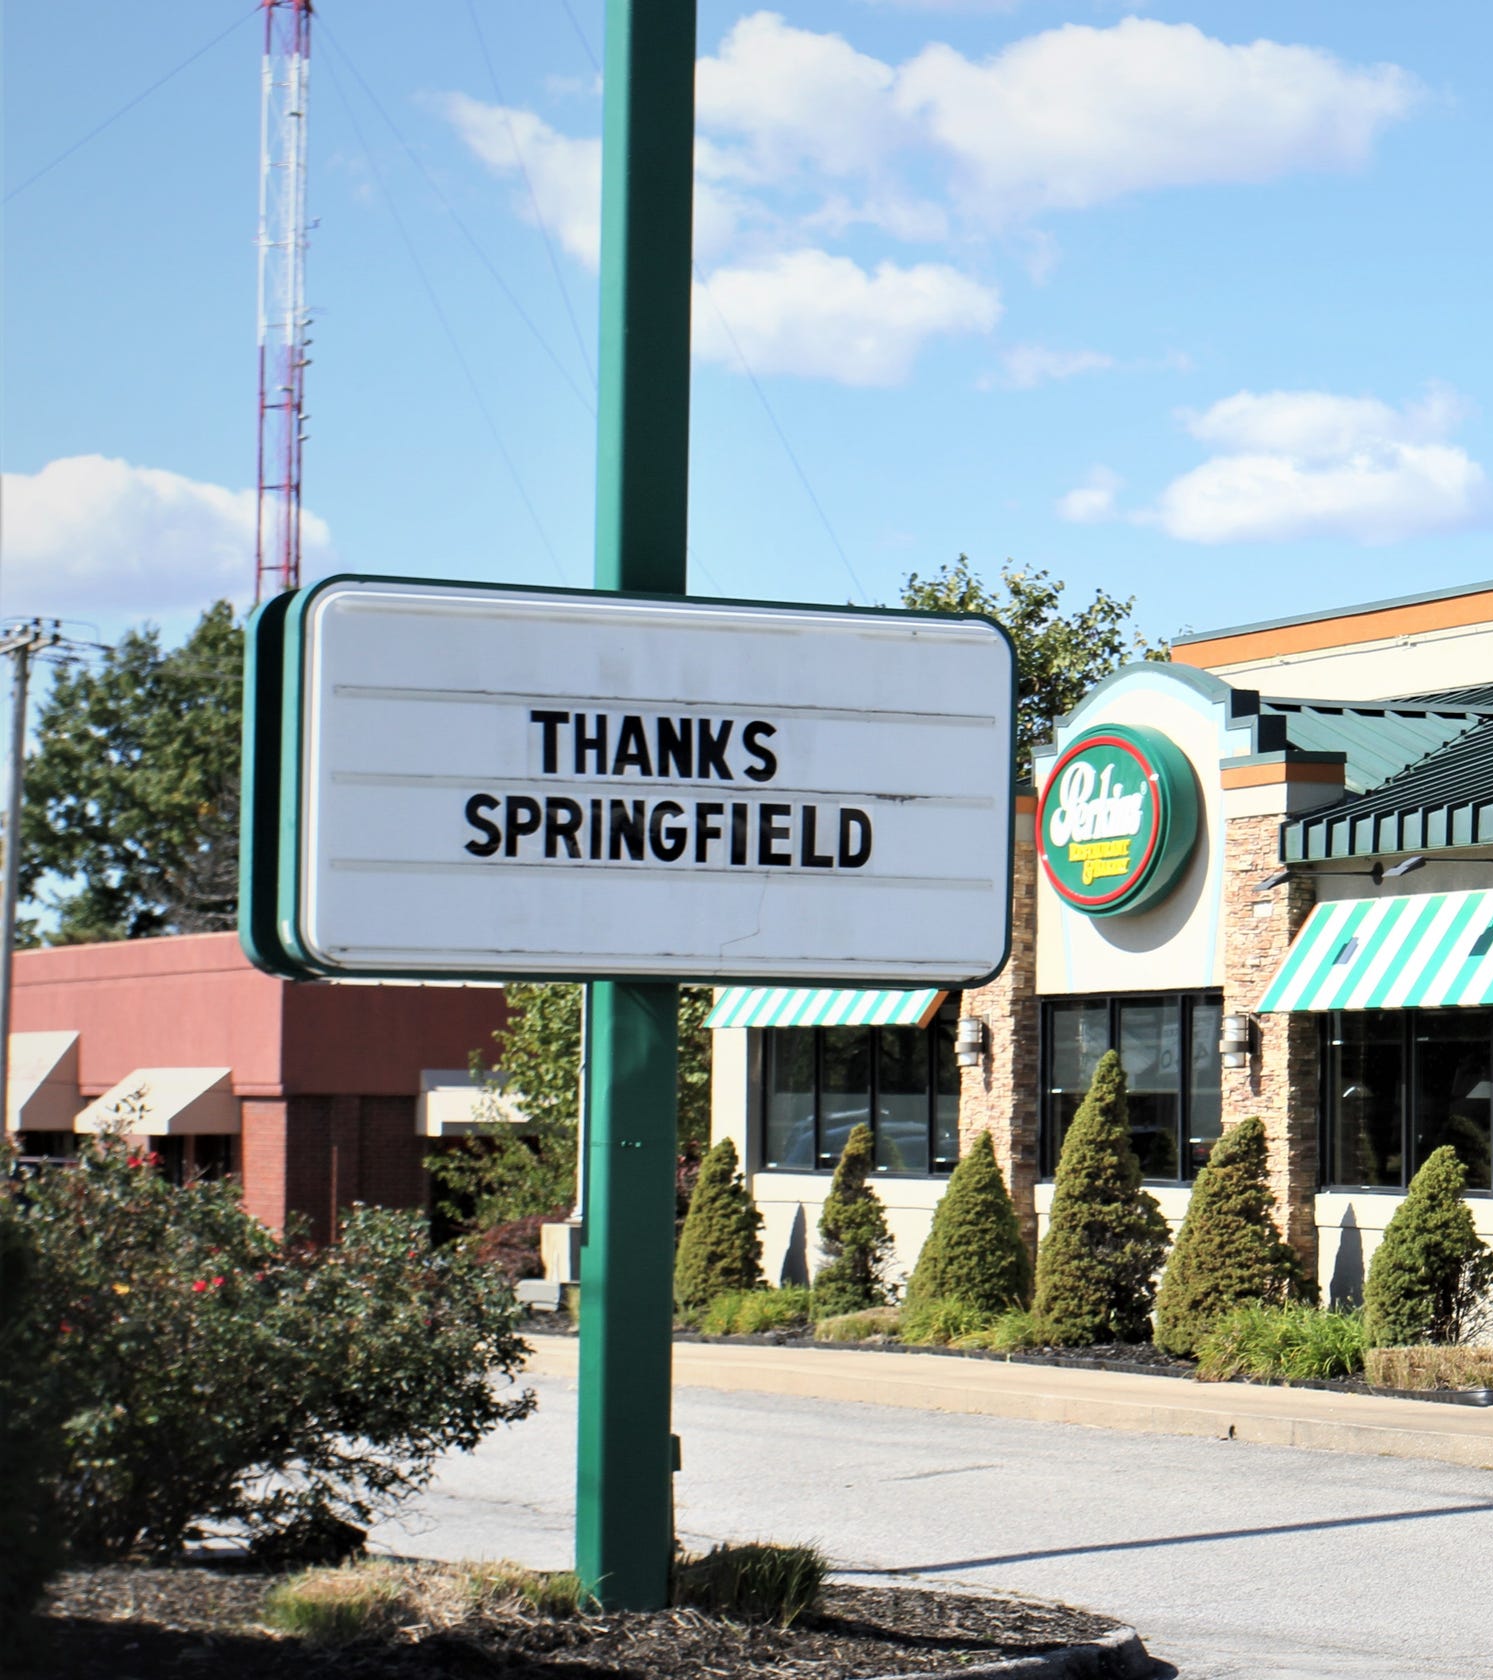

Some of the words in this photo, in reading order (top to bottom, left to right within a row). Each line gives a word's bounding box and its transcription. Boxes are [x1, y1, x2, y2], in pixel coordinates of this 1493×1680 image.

[530, 710, 777, 782] THANKS
[464, 793, 873, 868] SPRINGFIELD
[1051, 761, 1142, 847] Perkis
